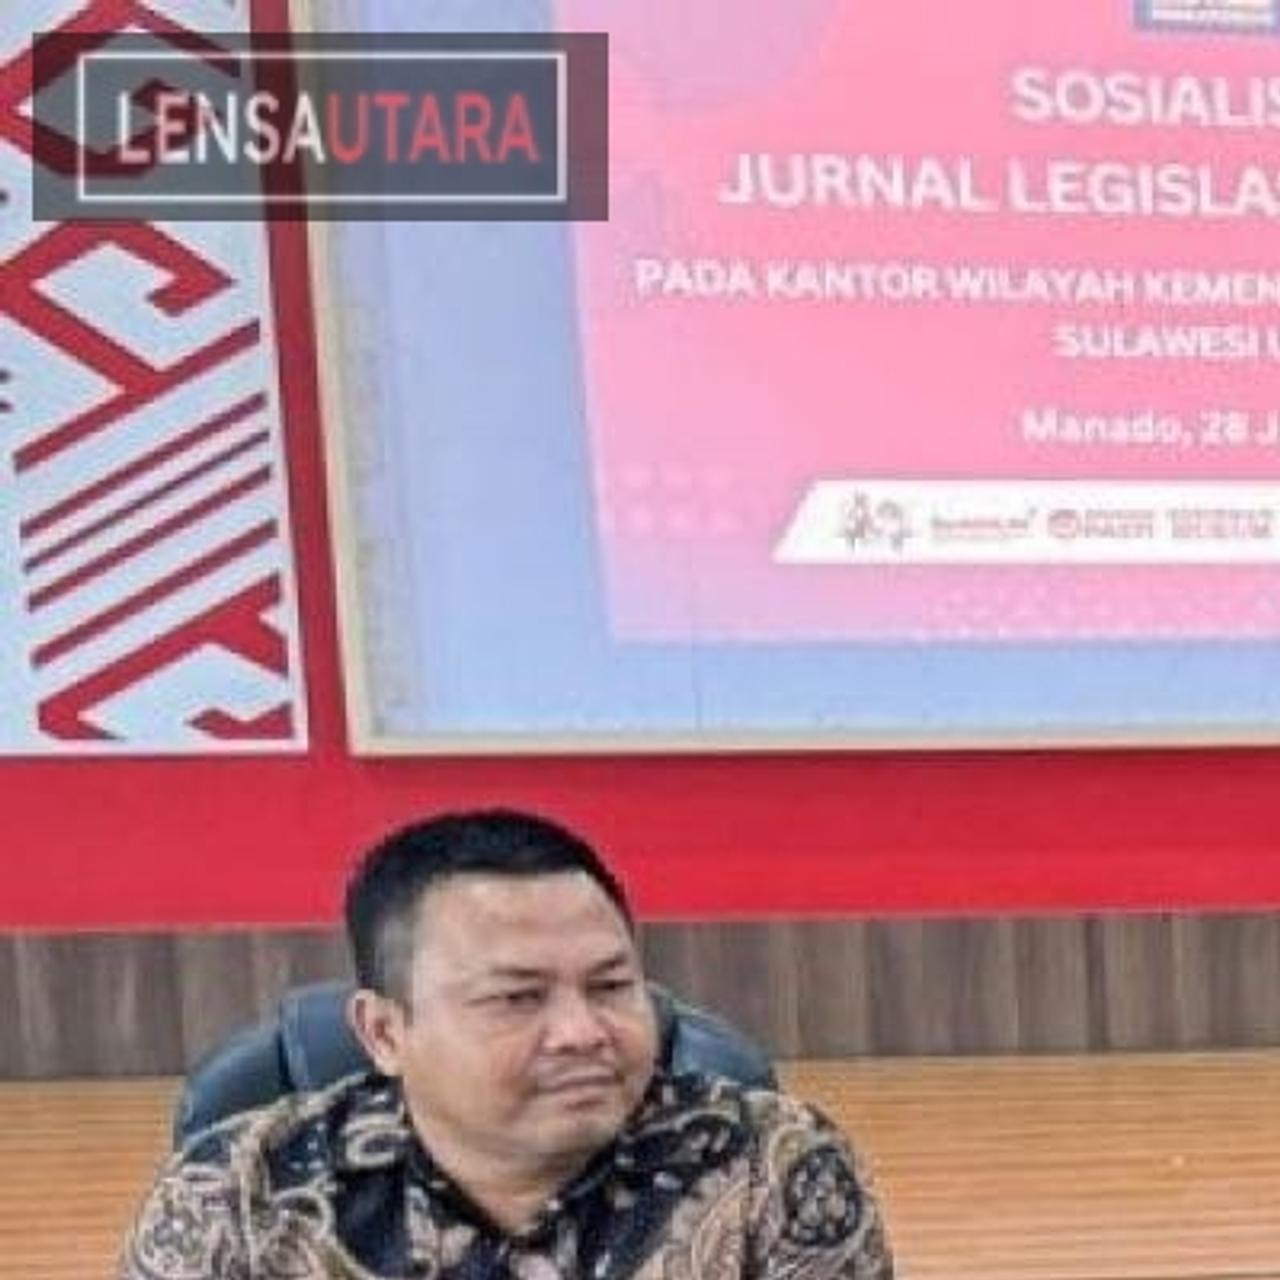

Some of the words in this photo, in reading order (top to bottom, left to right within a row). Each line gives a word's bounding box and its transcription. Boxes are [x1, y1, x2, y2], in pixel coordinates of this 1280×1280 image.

[718, 152, 996, 212] JURNAL
[634, 258, 754, 299] PADA
[765, 263, 939, 301] KANTOR
[947, 267, 1134, 304] WILAYAH
[1054, 324, 1259, 359] SULAWESI
[1021, 408, 1194, 448] Manado,
[1203, 410, 1247, 445] 28
